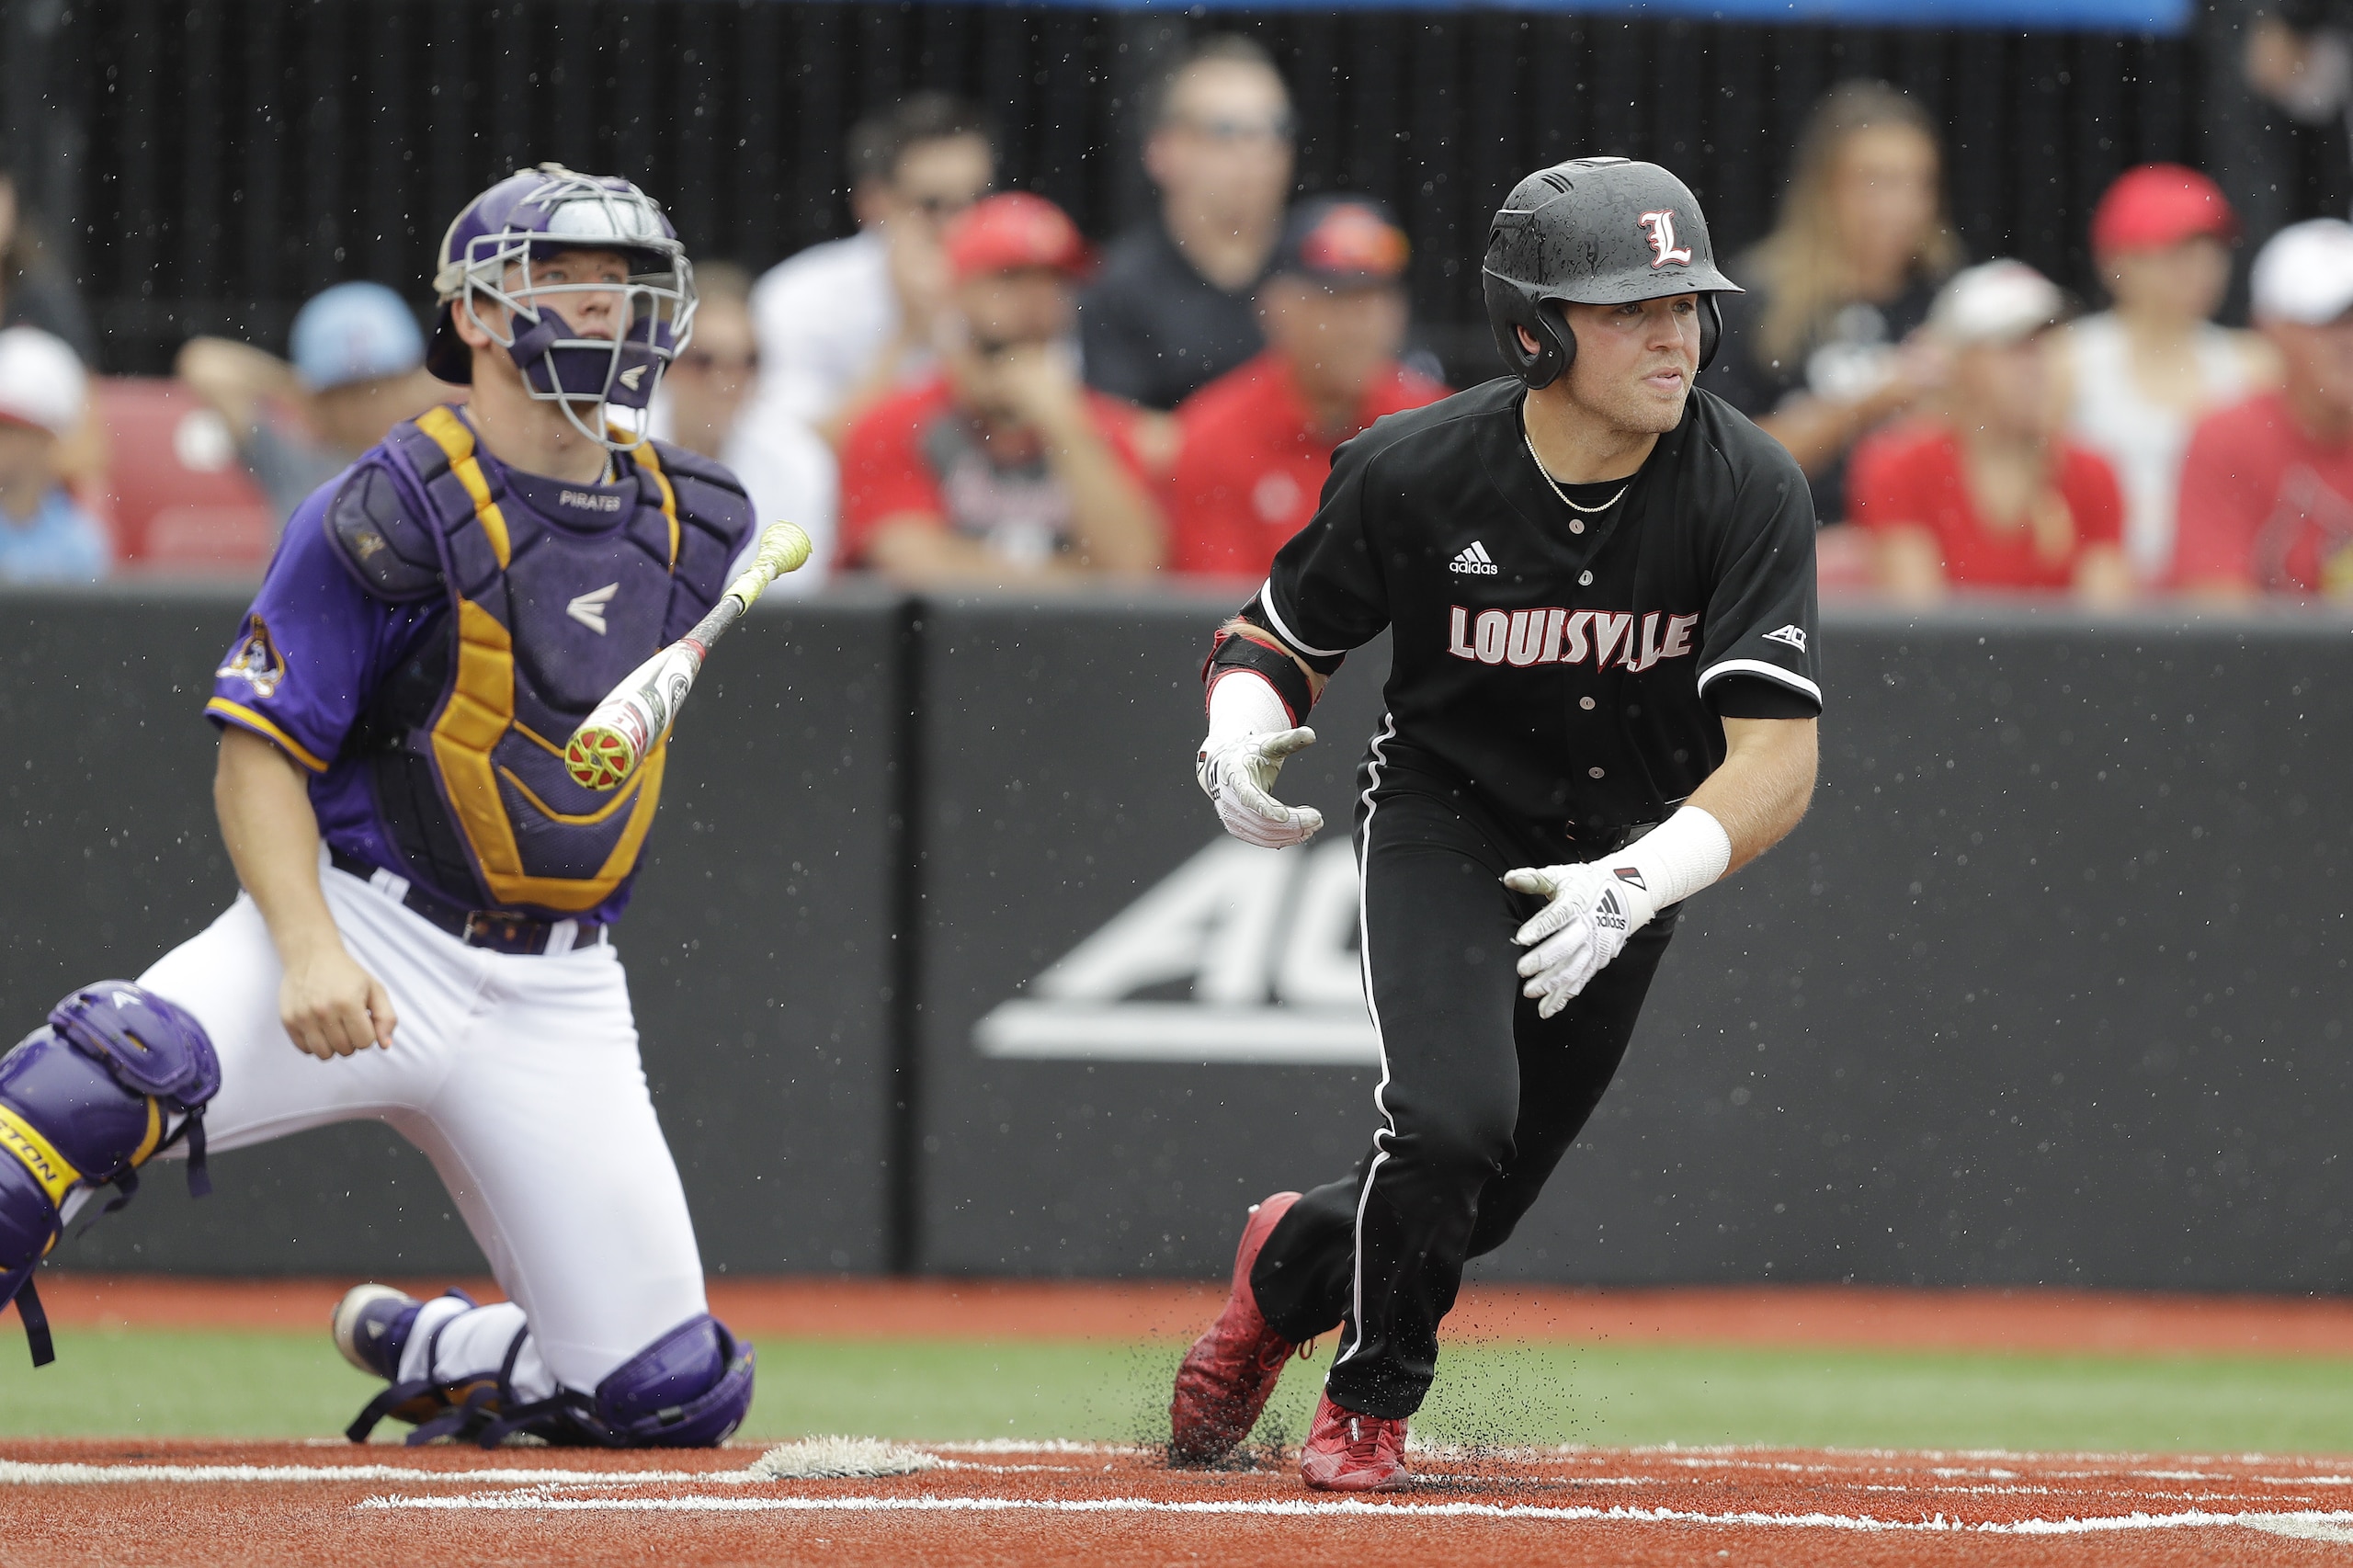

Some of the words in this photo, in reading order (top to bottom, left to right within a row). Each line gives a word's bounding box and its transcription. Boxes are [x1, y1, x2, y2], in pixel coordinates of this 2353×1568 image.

[1638, 209, 1692, 268] L
[559, 490, 621, 512] PIRATES
[1449, 560, 1498, 575] adidas
[1447, 604, 1700, 675] LOUISVILE
[1026, 831, 1364, 1006] AC
